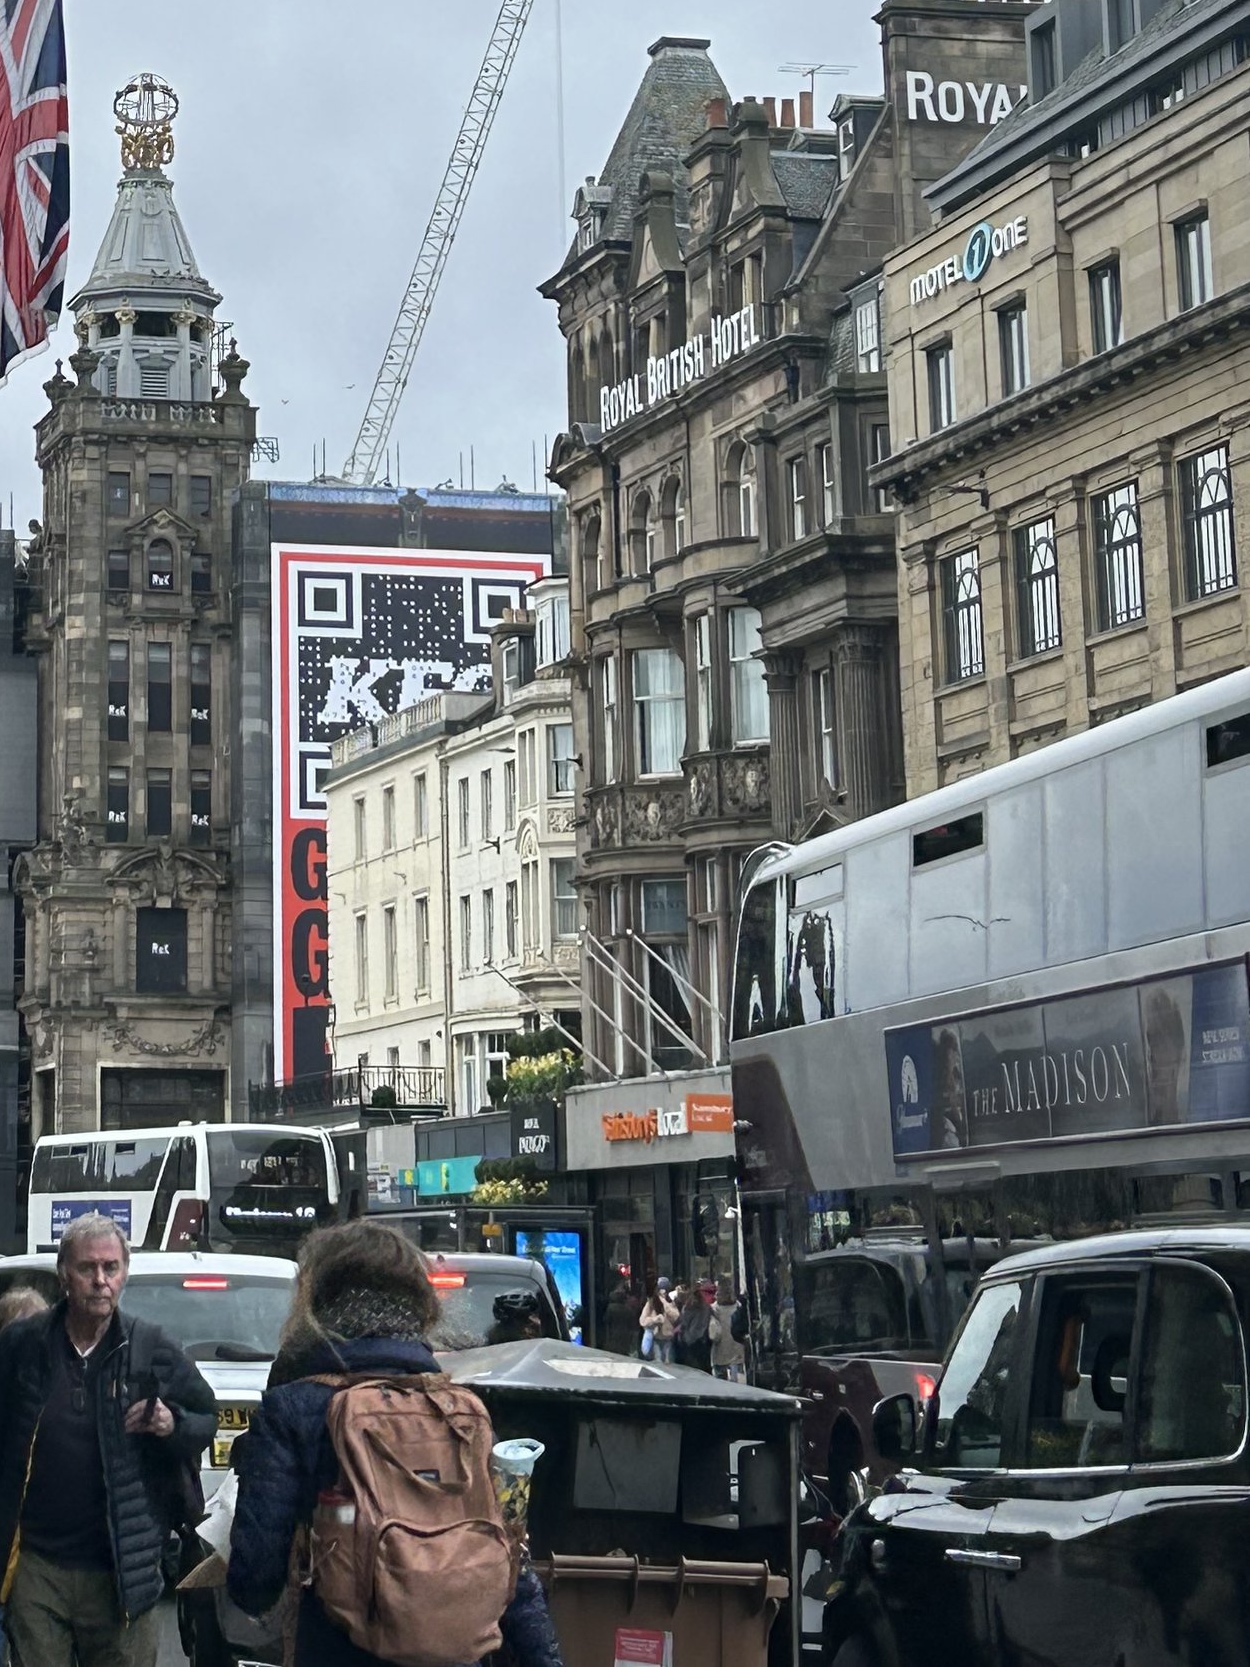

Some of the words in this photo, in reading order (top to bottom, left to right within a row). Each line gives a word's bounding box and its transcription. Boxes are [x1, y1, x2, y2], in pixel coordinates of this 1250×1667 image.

[906, 70, 1028, 125] ROYA
[600, 373, 644, 433] ROYAL
[647, 334, 704, 405] BRITISH
[711, 302, 760, 368] HOTEL
[973, 1088, 997, 1117] THE
[1001, 1042, 1130, 1113] MADISON
